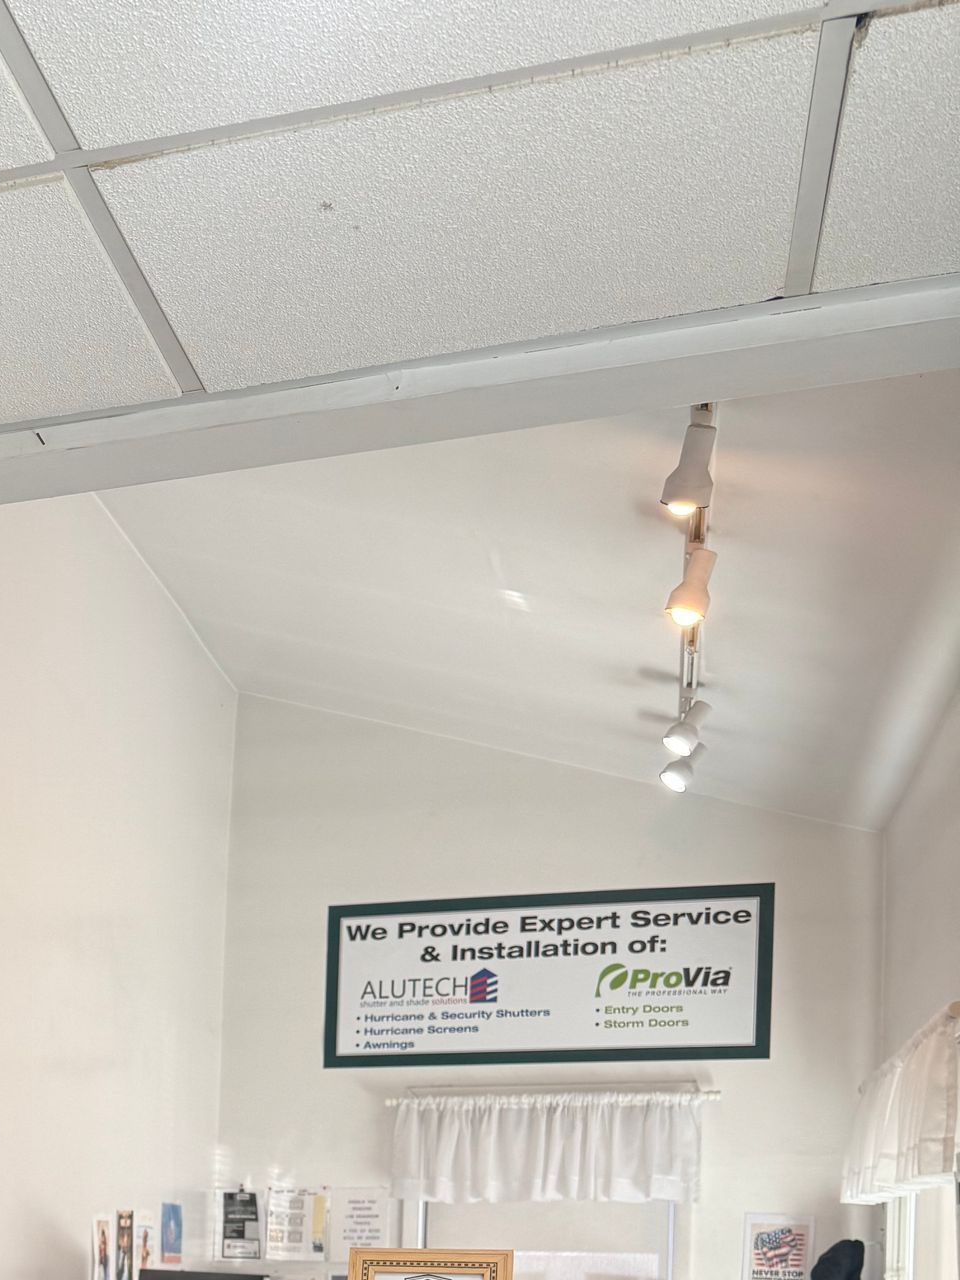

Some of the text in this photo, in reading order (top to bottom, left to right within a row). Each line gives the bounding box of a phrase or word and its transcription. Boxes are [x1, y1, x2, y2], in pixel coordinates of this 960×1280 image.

[347, 907, 751, 941] We Provide Expert Service
[421, 936, 667, 962] & Installation of:
[629, 967, 731, 989] ProVia
[360, 977, 468, 1000] ALUTECH
[645, 989, 707, 997] PROFESSIONAL
[431, 997, 467, 1005] solutions
[604, 1005, 684, 1015] Entry Doors
[364, 1009, 550, 1023] Hurricane & Security Shutters
[604, 1019, 689, 1028] Storm Doors
[364, 1025, 479, 1036] Hurricane Screens
[363, 1040, 414, 1049] Awnings
